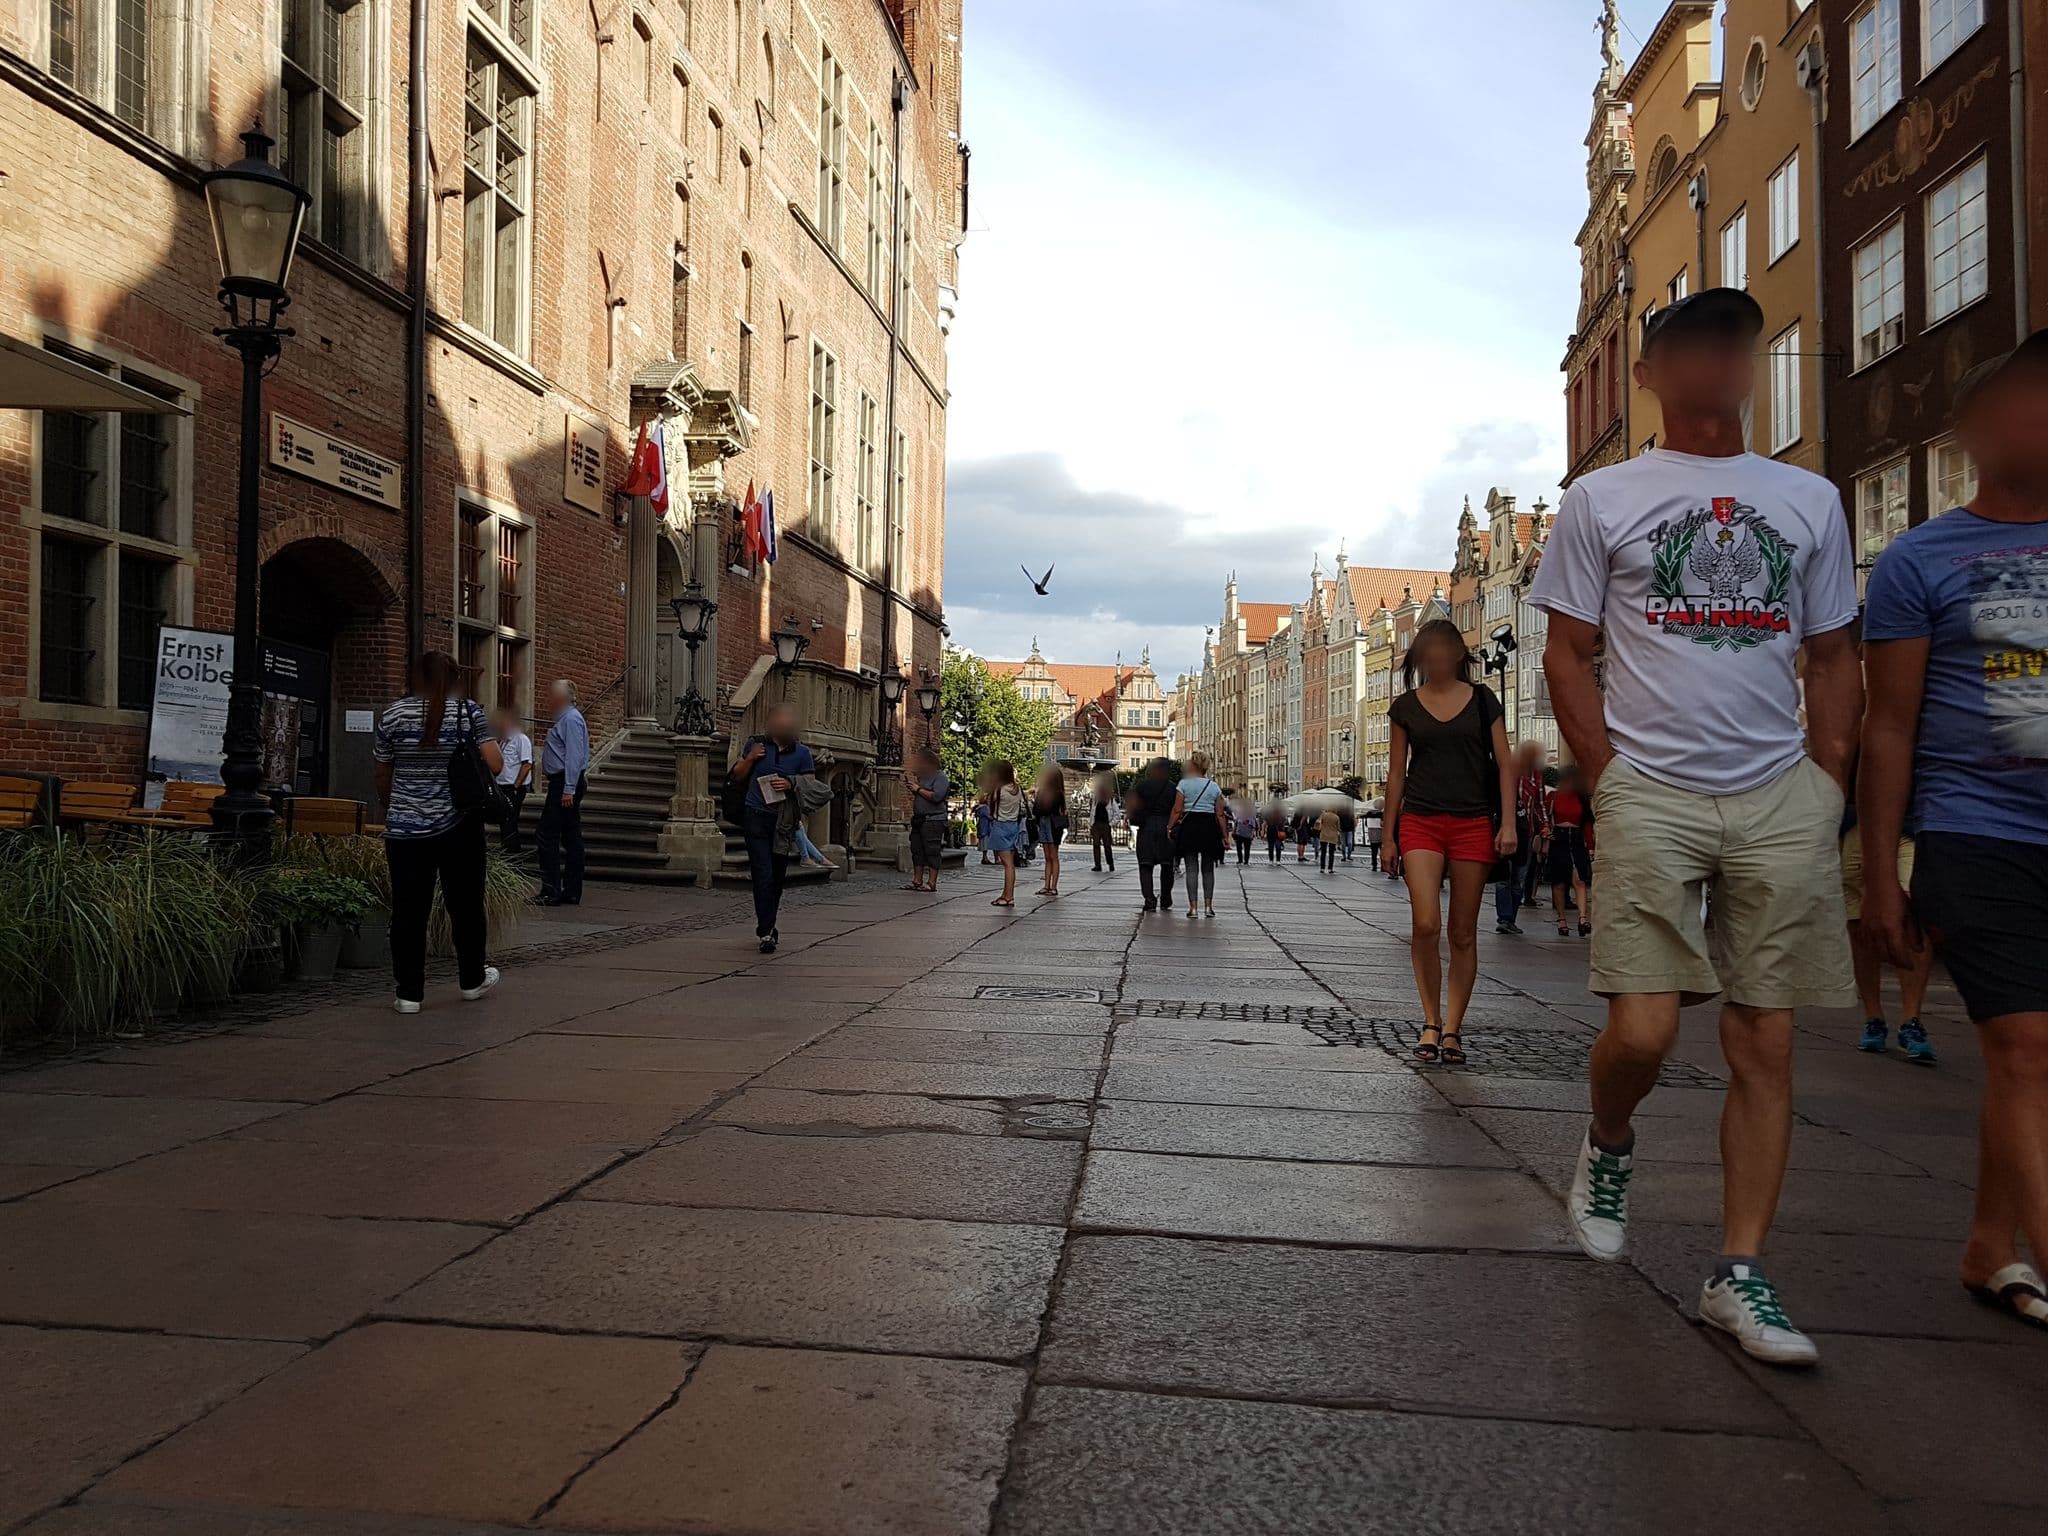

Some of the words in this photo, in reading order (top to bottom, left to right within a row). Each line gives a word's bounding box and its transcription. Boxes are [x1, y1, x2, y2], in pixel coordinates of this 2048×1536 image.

[1974, 605, 2025, 623] ABOUT
[2032, 604, 2042, 619] 6
[162, 636, 225, 663] Ernst
[160, 657, 233, 685] Kolbe
